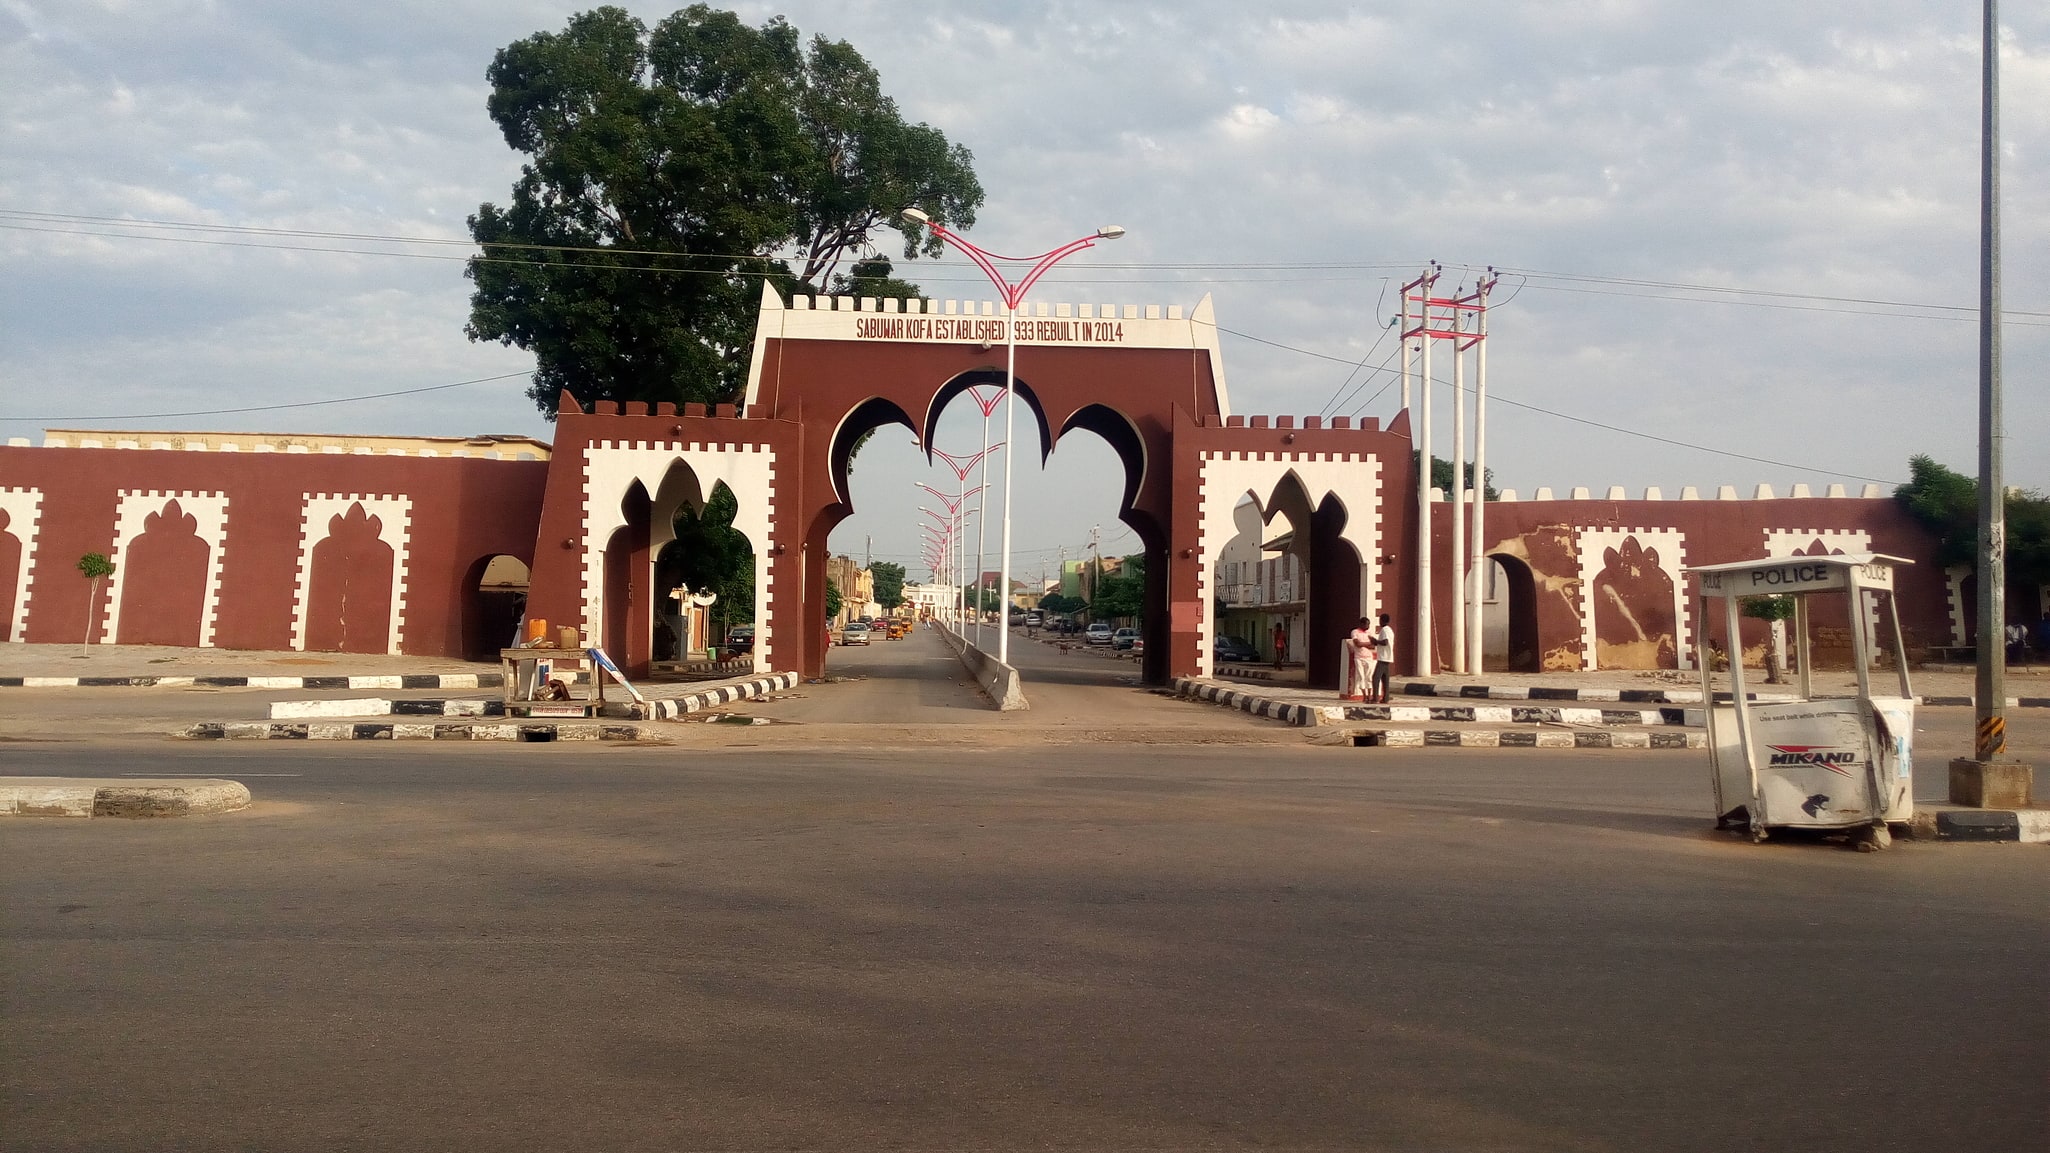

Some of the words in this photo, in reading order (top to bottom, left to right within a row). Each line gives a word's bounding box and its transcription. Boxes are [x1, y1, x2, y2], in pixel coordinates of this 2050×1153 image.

[857, 318, 903, 339] SABUWAR
[907, 318, 932, 339] KOFA
[936, 319, 1004, 341] ESTABLISHED
[1008, 320, 1034, 340] 933
[1037, 321, 1079, 341] REBUILT
[1082, 321, 1092, 341] IN
[1095, 321, 1123, 342] 2014
[1703, 572, 1721, 589] POLICE
[1752, 565, 1828, 586] POLICE
[1860, 564, 1886, 581] POLICE
[1770, 752, 1855, 764] MIKANO
